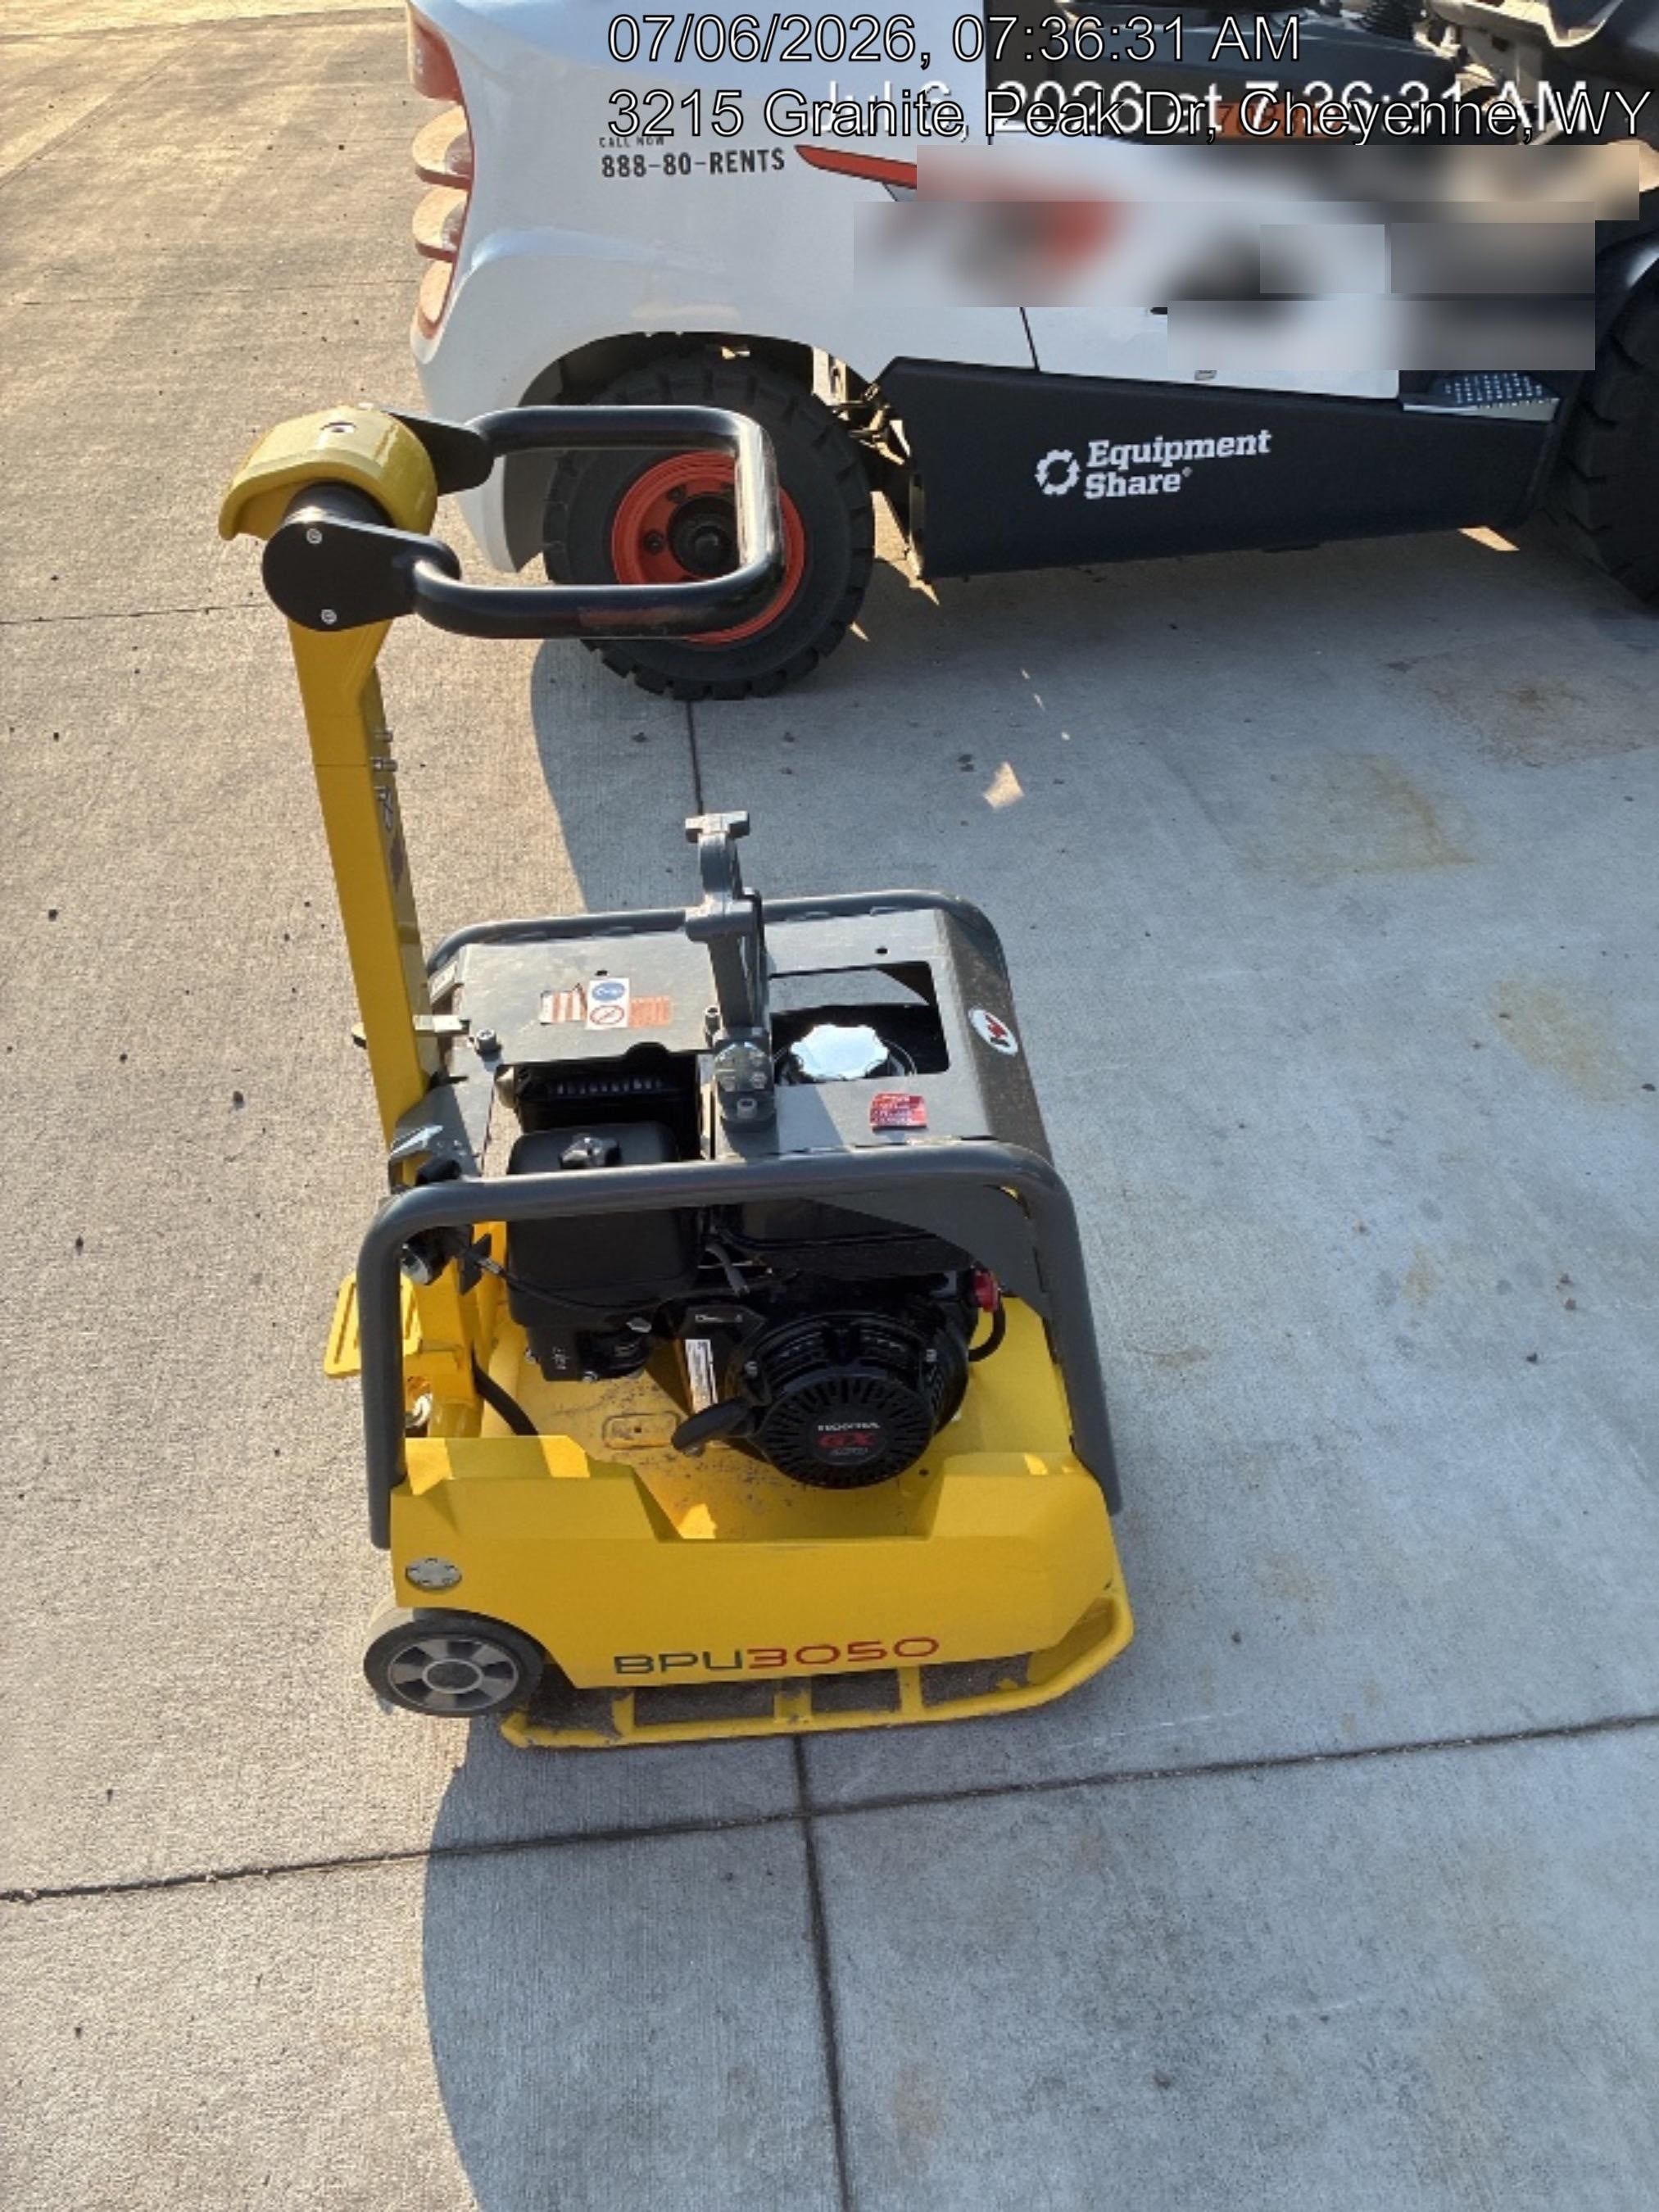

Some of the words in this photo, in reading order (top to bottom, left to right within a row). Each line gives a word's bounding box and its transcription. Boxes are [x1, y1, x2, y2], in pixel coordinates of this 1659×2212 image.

[599, 137, 630, 148] CALL
[637, 136, 665, 147] NOW
[601, 147, 785, 178] 888-80-RENTS
[1086, 429, 1272, 470] Equipment
[614, 1637, 940, 1675] BPU3050
